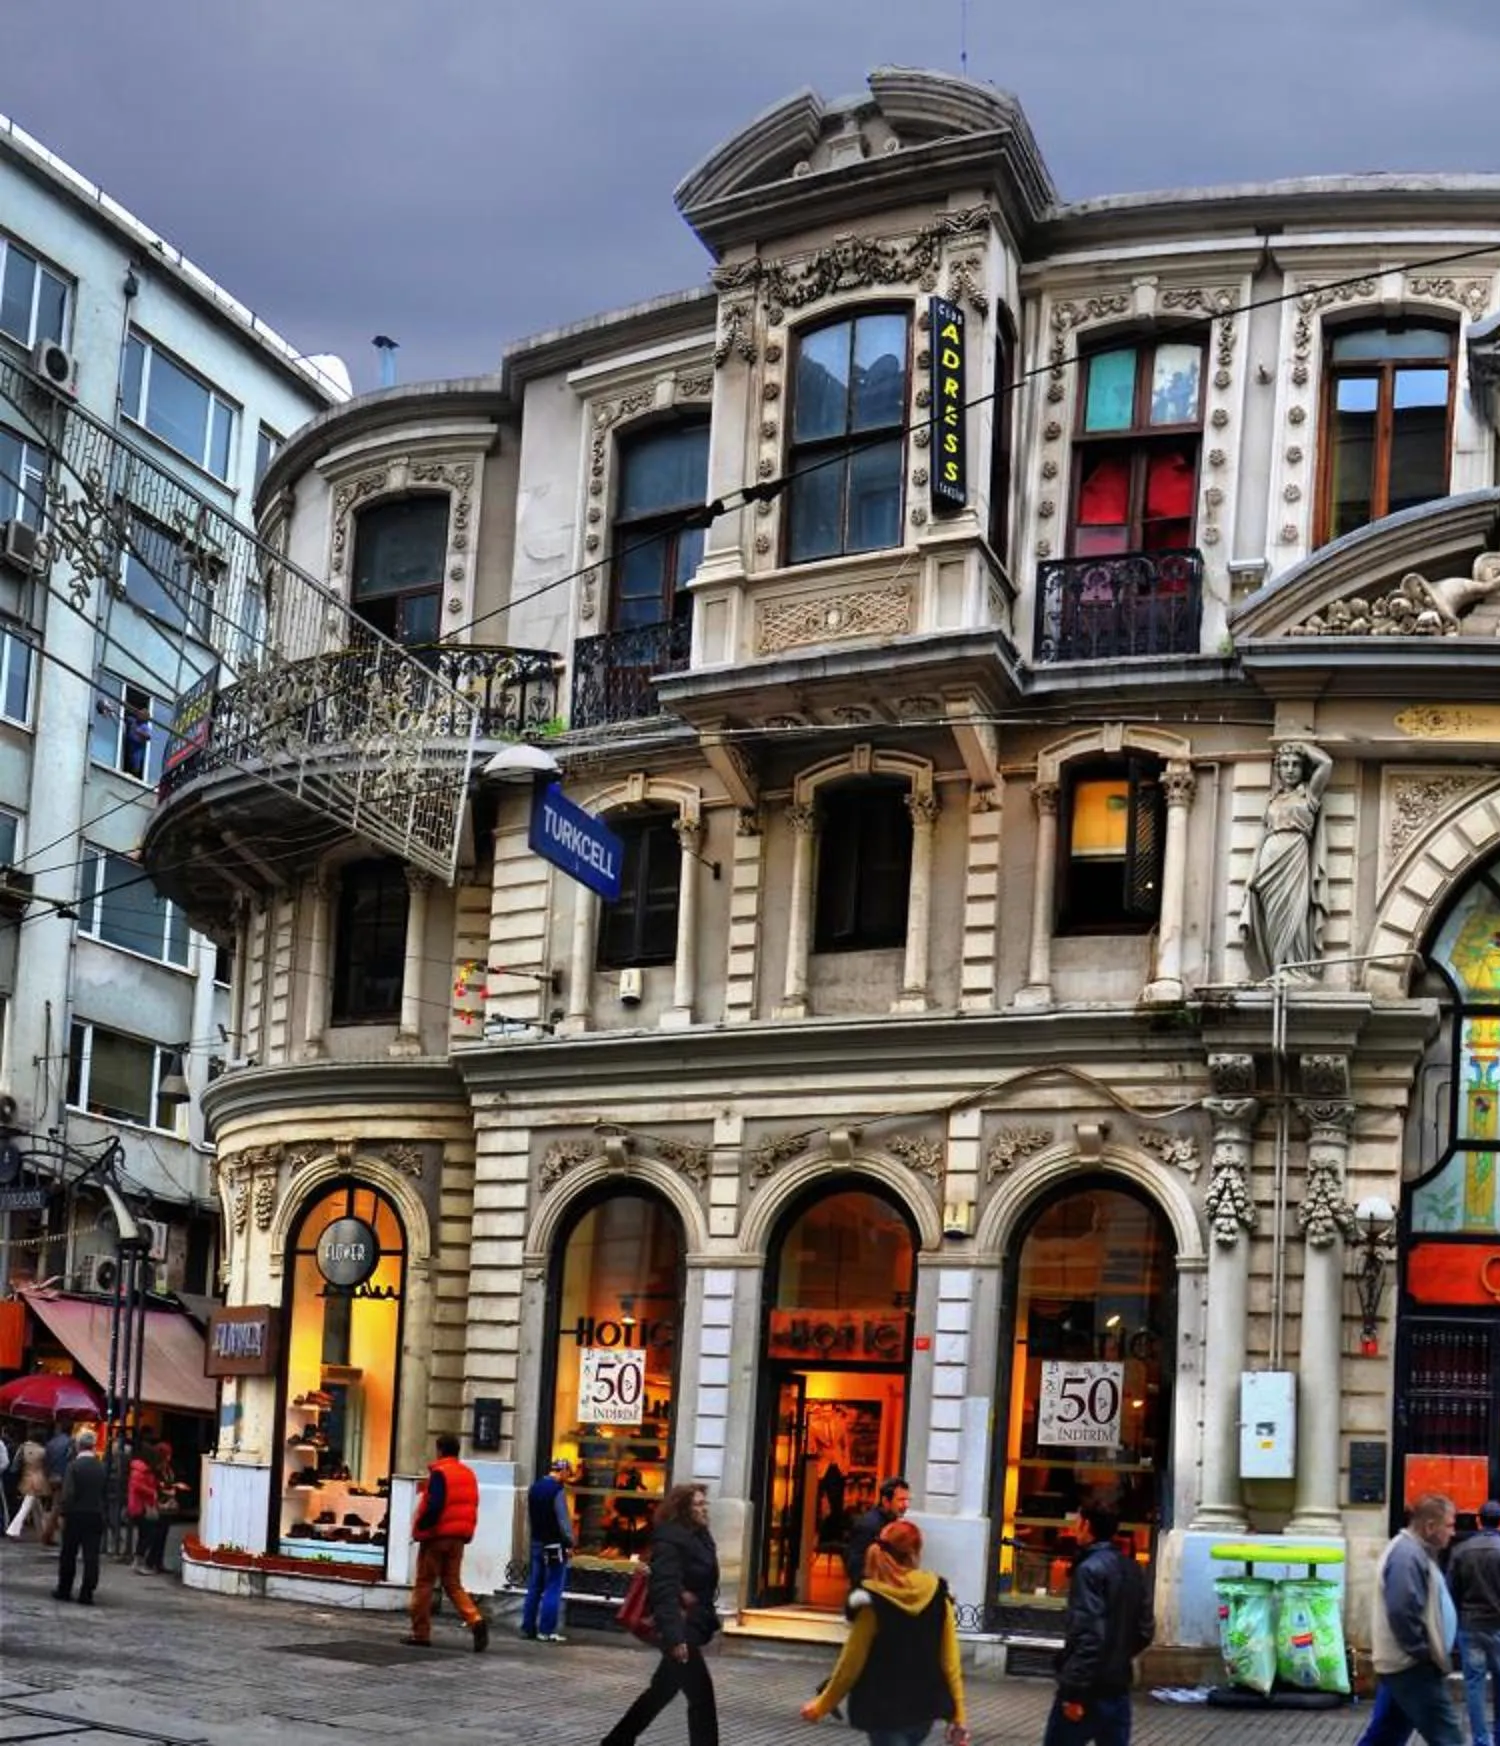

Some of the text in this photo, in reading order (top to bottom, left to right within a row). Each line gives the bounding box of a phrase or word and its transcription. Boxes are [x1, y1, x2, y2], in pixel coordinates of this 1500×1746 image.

[941, 323, 960, 482] ADRESS
[544, 805, 615, 880] TURKCELL
[325, 1243, 366, 1264] FLOWER
[592, 1363, 642, 1405] 50
[1056, 1377, 1119, 1424] 50
